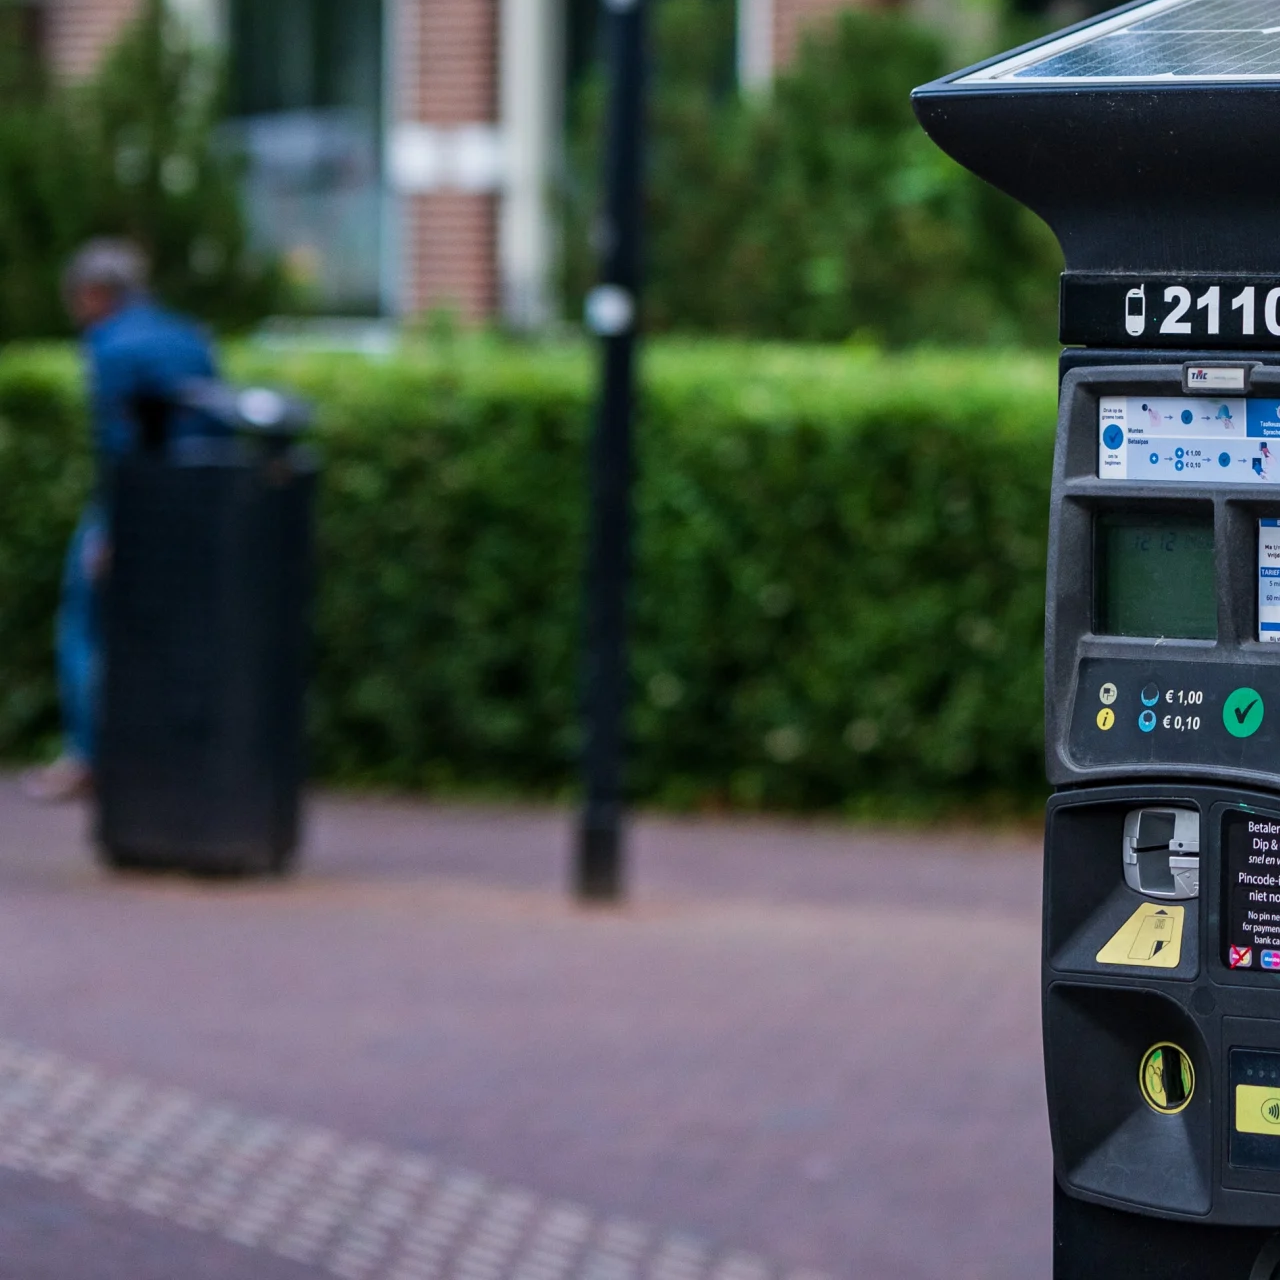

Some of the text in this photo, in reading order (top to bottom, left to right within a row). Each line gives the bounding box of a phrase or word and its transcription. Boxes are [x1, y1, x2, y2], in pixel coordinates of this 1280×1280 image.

[1165, 689, 1203, 706] € 1,00
[1163, 715, 1200, 731] € 0,10
[1252, 838, 1269, 852] Dip
[1270, 839, 1278, 851] &
[1248, 854, 1264, 864] snel
[1265, 856, 1275, 865] en
[1249, 890, 1267, 902] niet
[1248, 910, 1258, 920] No
[1259, 912, 1270, 922] pin
[1242, 922, 1252, 931] for
[1254, 935, 1271, 944] bank
